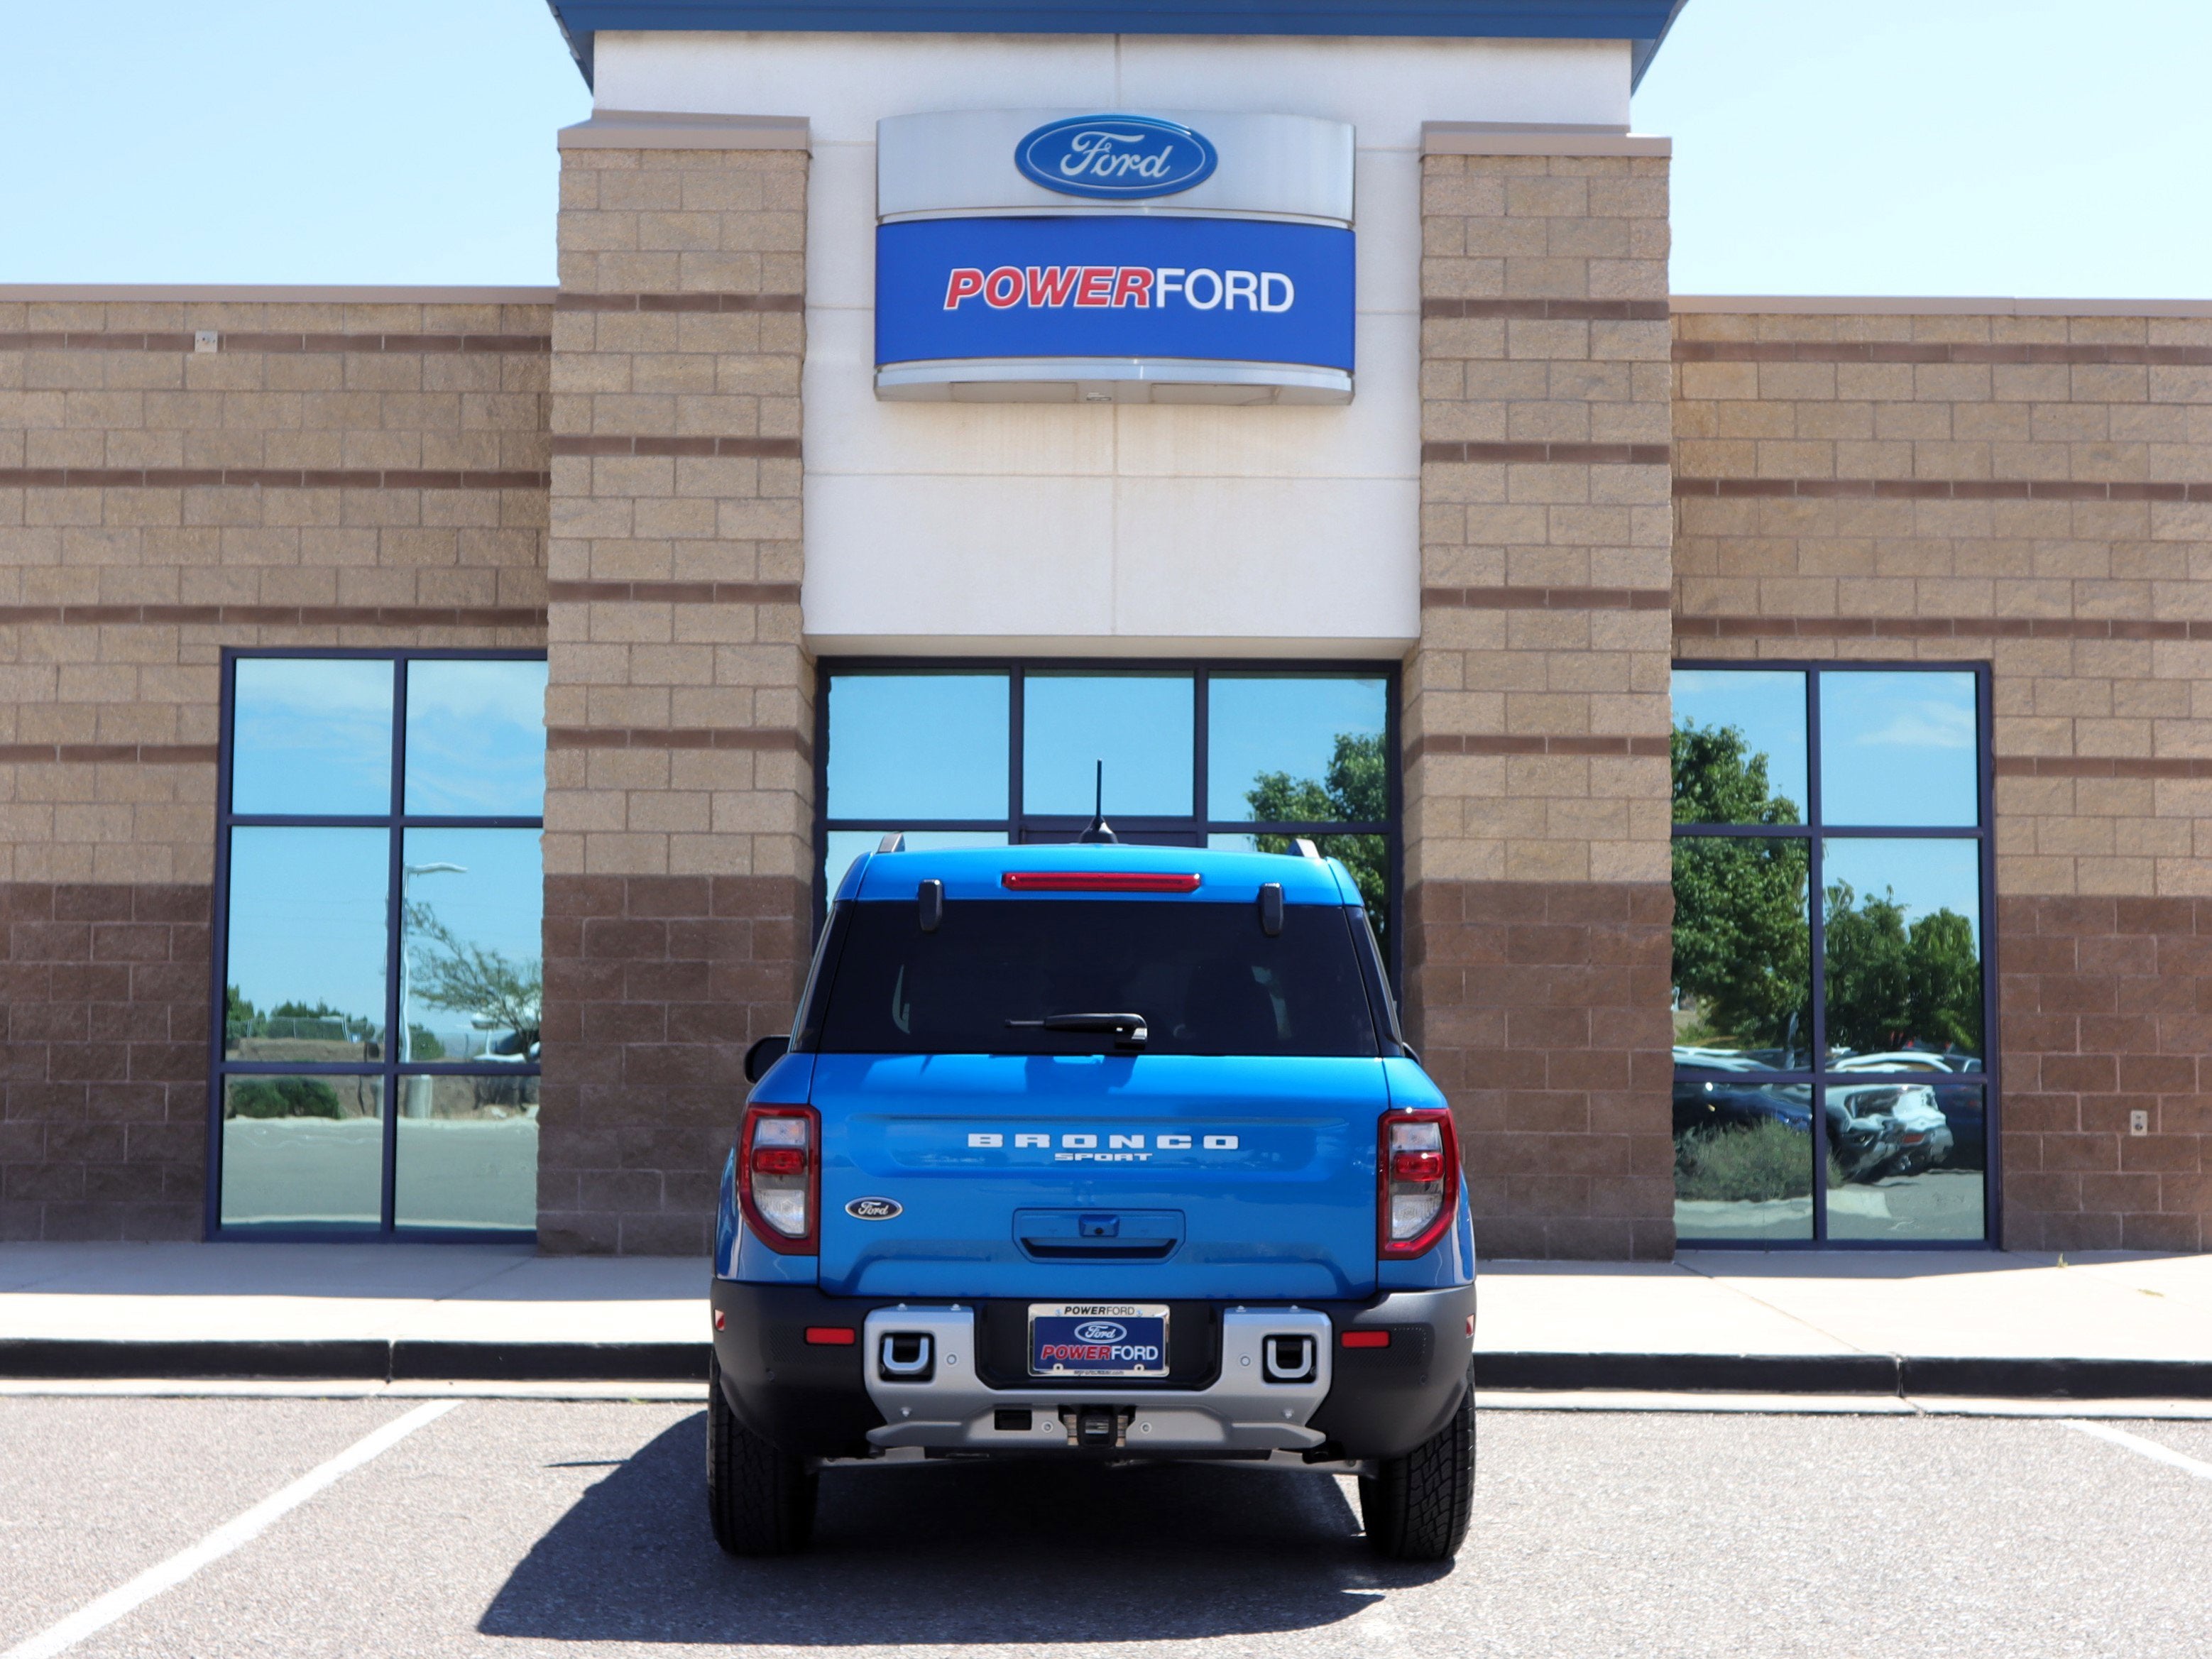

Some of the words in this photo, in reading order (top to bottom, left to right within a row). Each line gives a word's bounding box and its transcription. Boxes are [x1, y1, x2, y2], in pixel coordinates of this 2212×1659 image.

[1060, 131, 1173, 177] Ford
[943, 265, 1295, 312] POWERFORD
[968, 1133, 1239, 1150] BRONCO
[1054, 1153, 1153, 1161] SPORT
[858, 1201, 889, 1215] Ford
[1064, 1306, 1135, 1315] POWERFORD
[1085, 1325, 1117, 1339] Ford
[1041, 1345, 1159, 1360] POWERFORD
